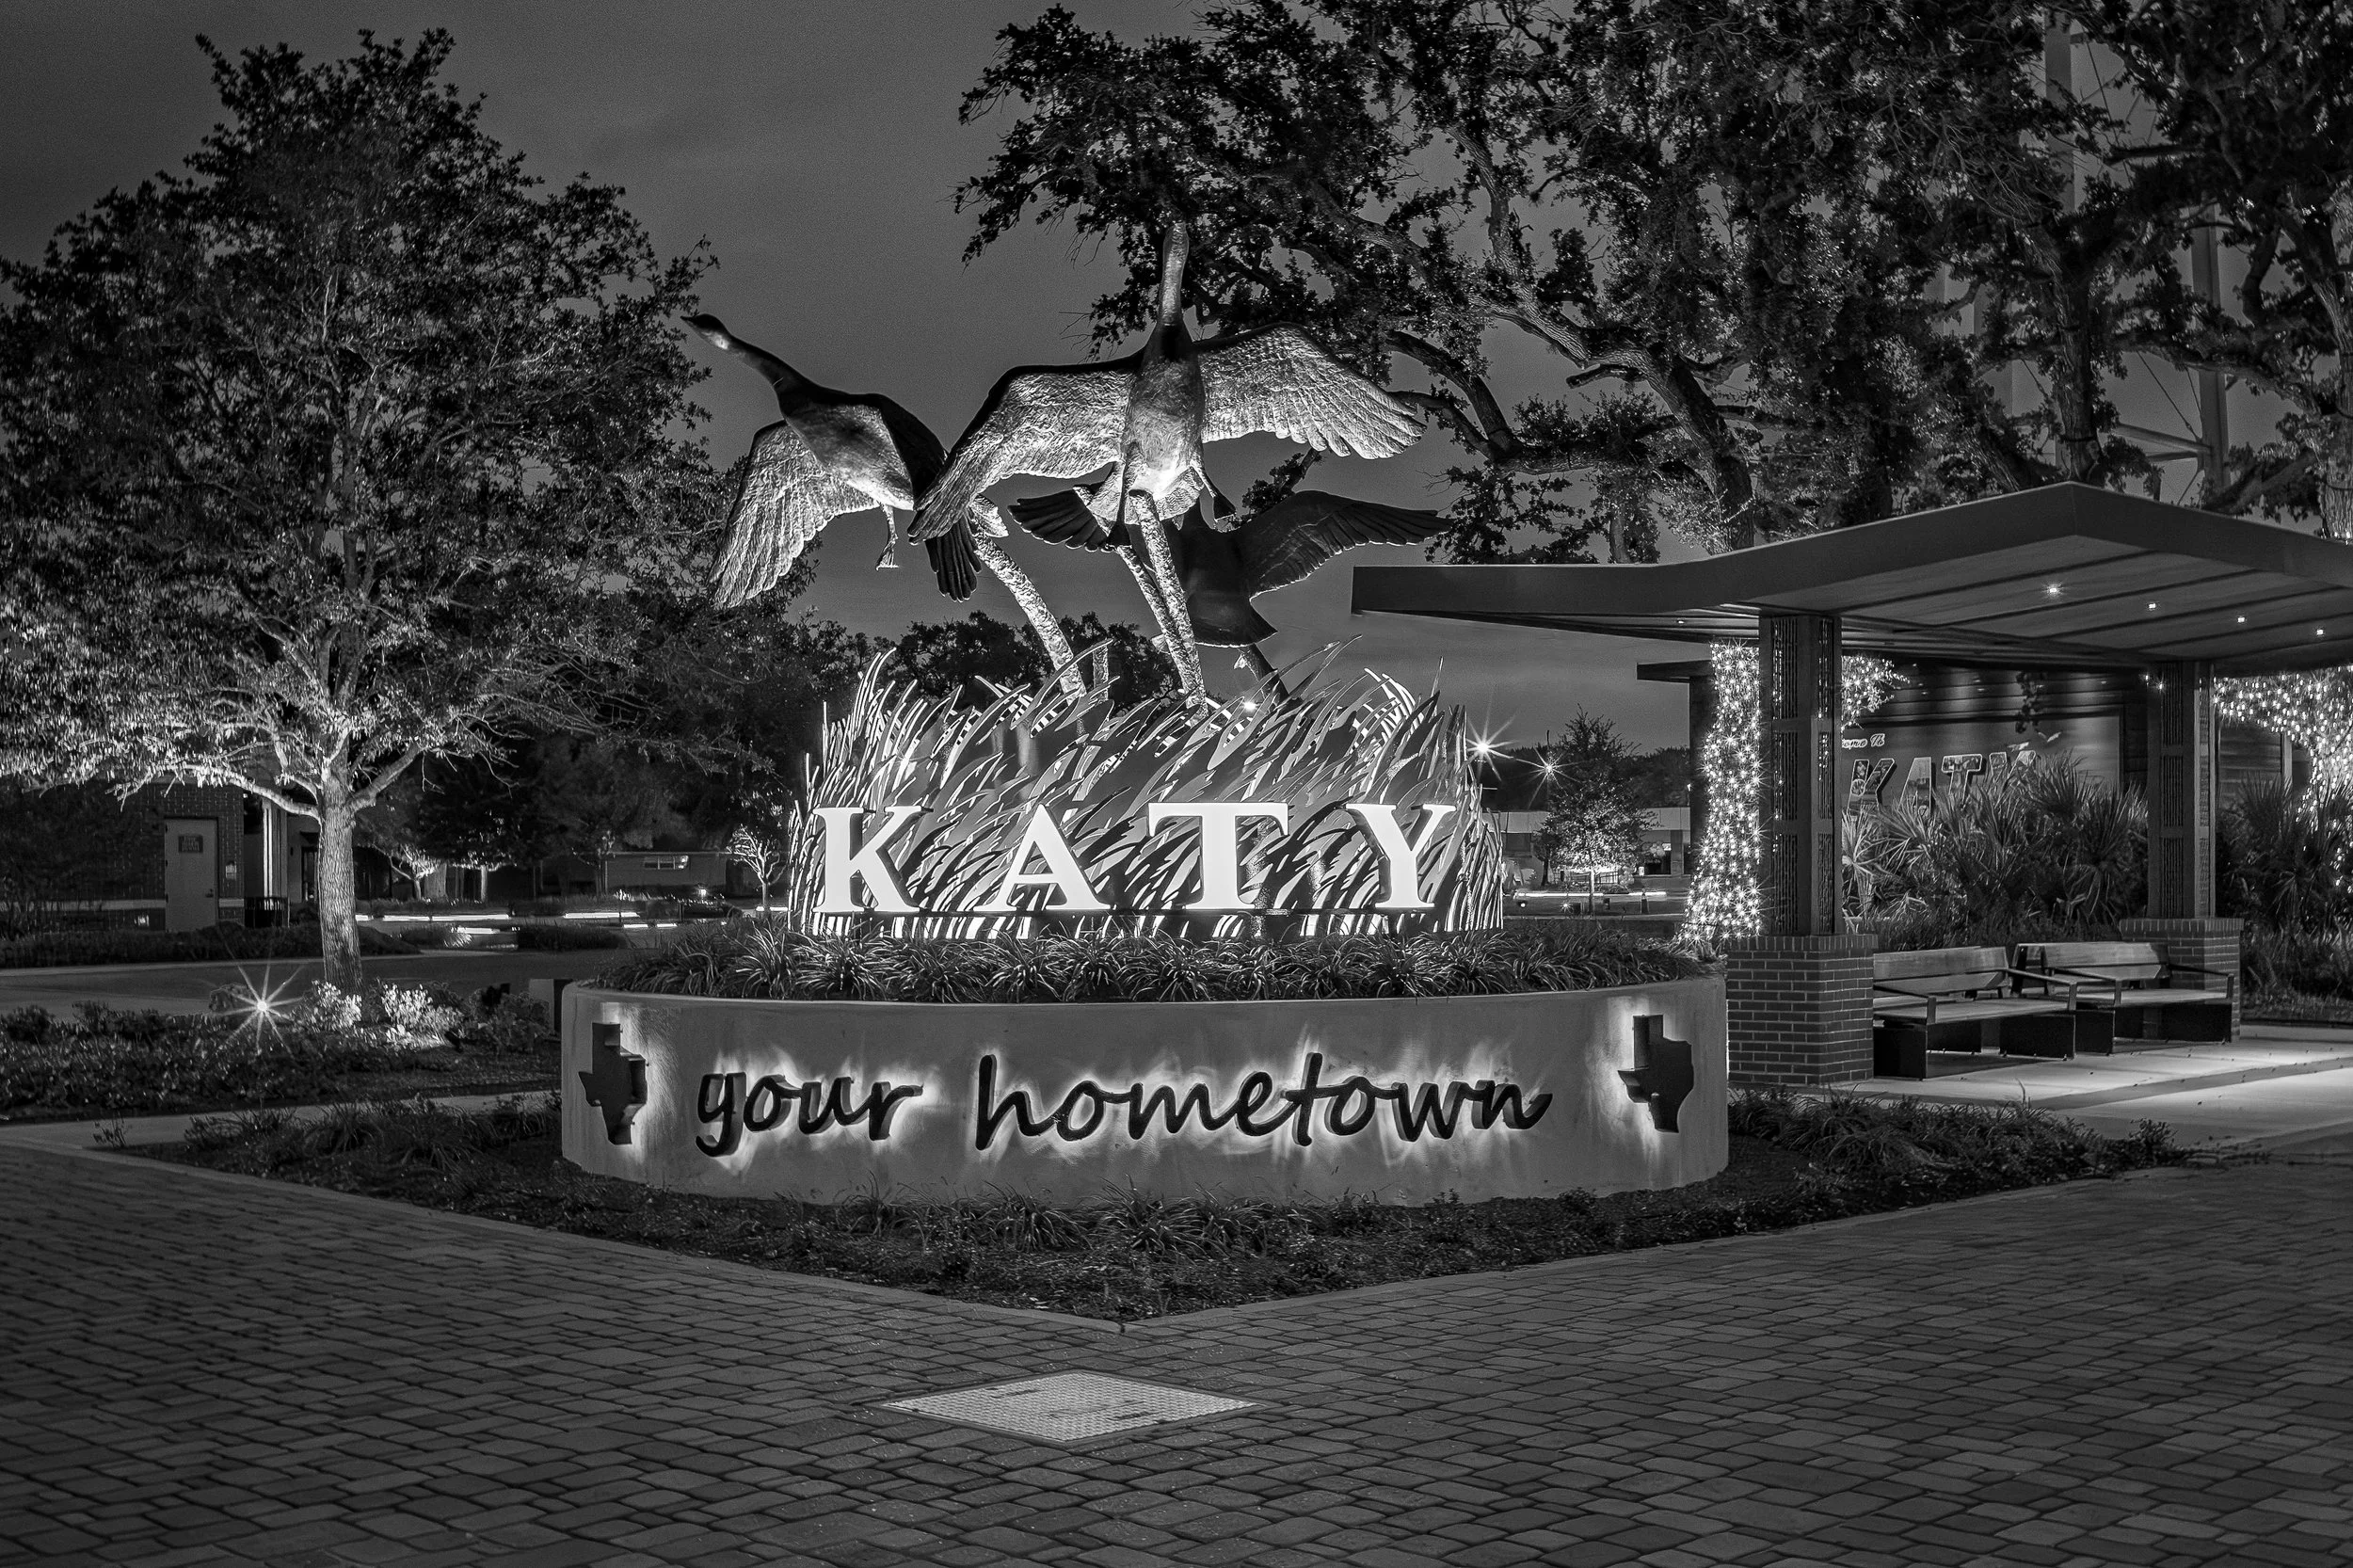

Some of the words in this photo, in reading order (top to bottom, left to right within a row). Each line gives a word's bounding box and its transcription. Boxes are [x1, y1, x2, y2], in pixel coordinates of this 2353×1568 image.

[812, 802, 1455, 913] KATY
[696, 1072, 923, 1157] your
[976, 1052, 1553, 1150] hometown
